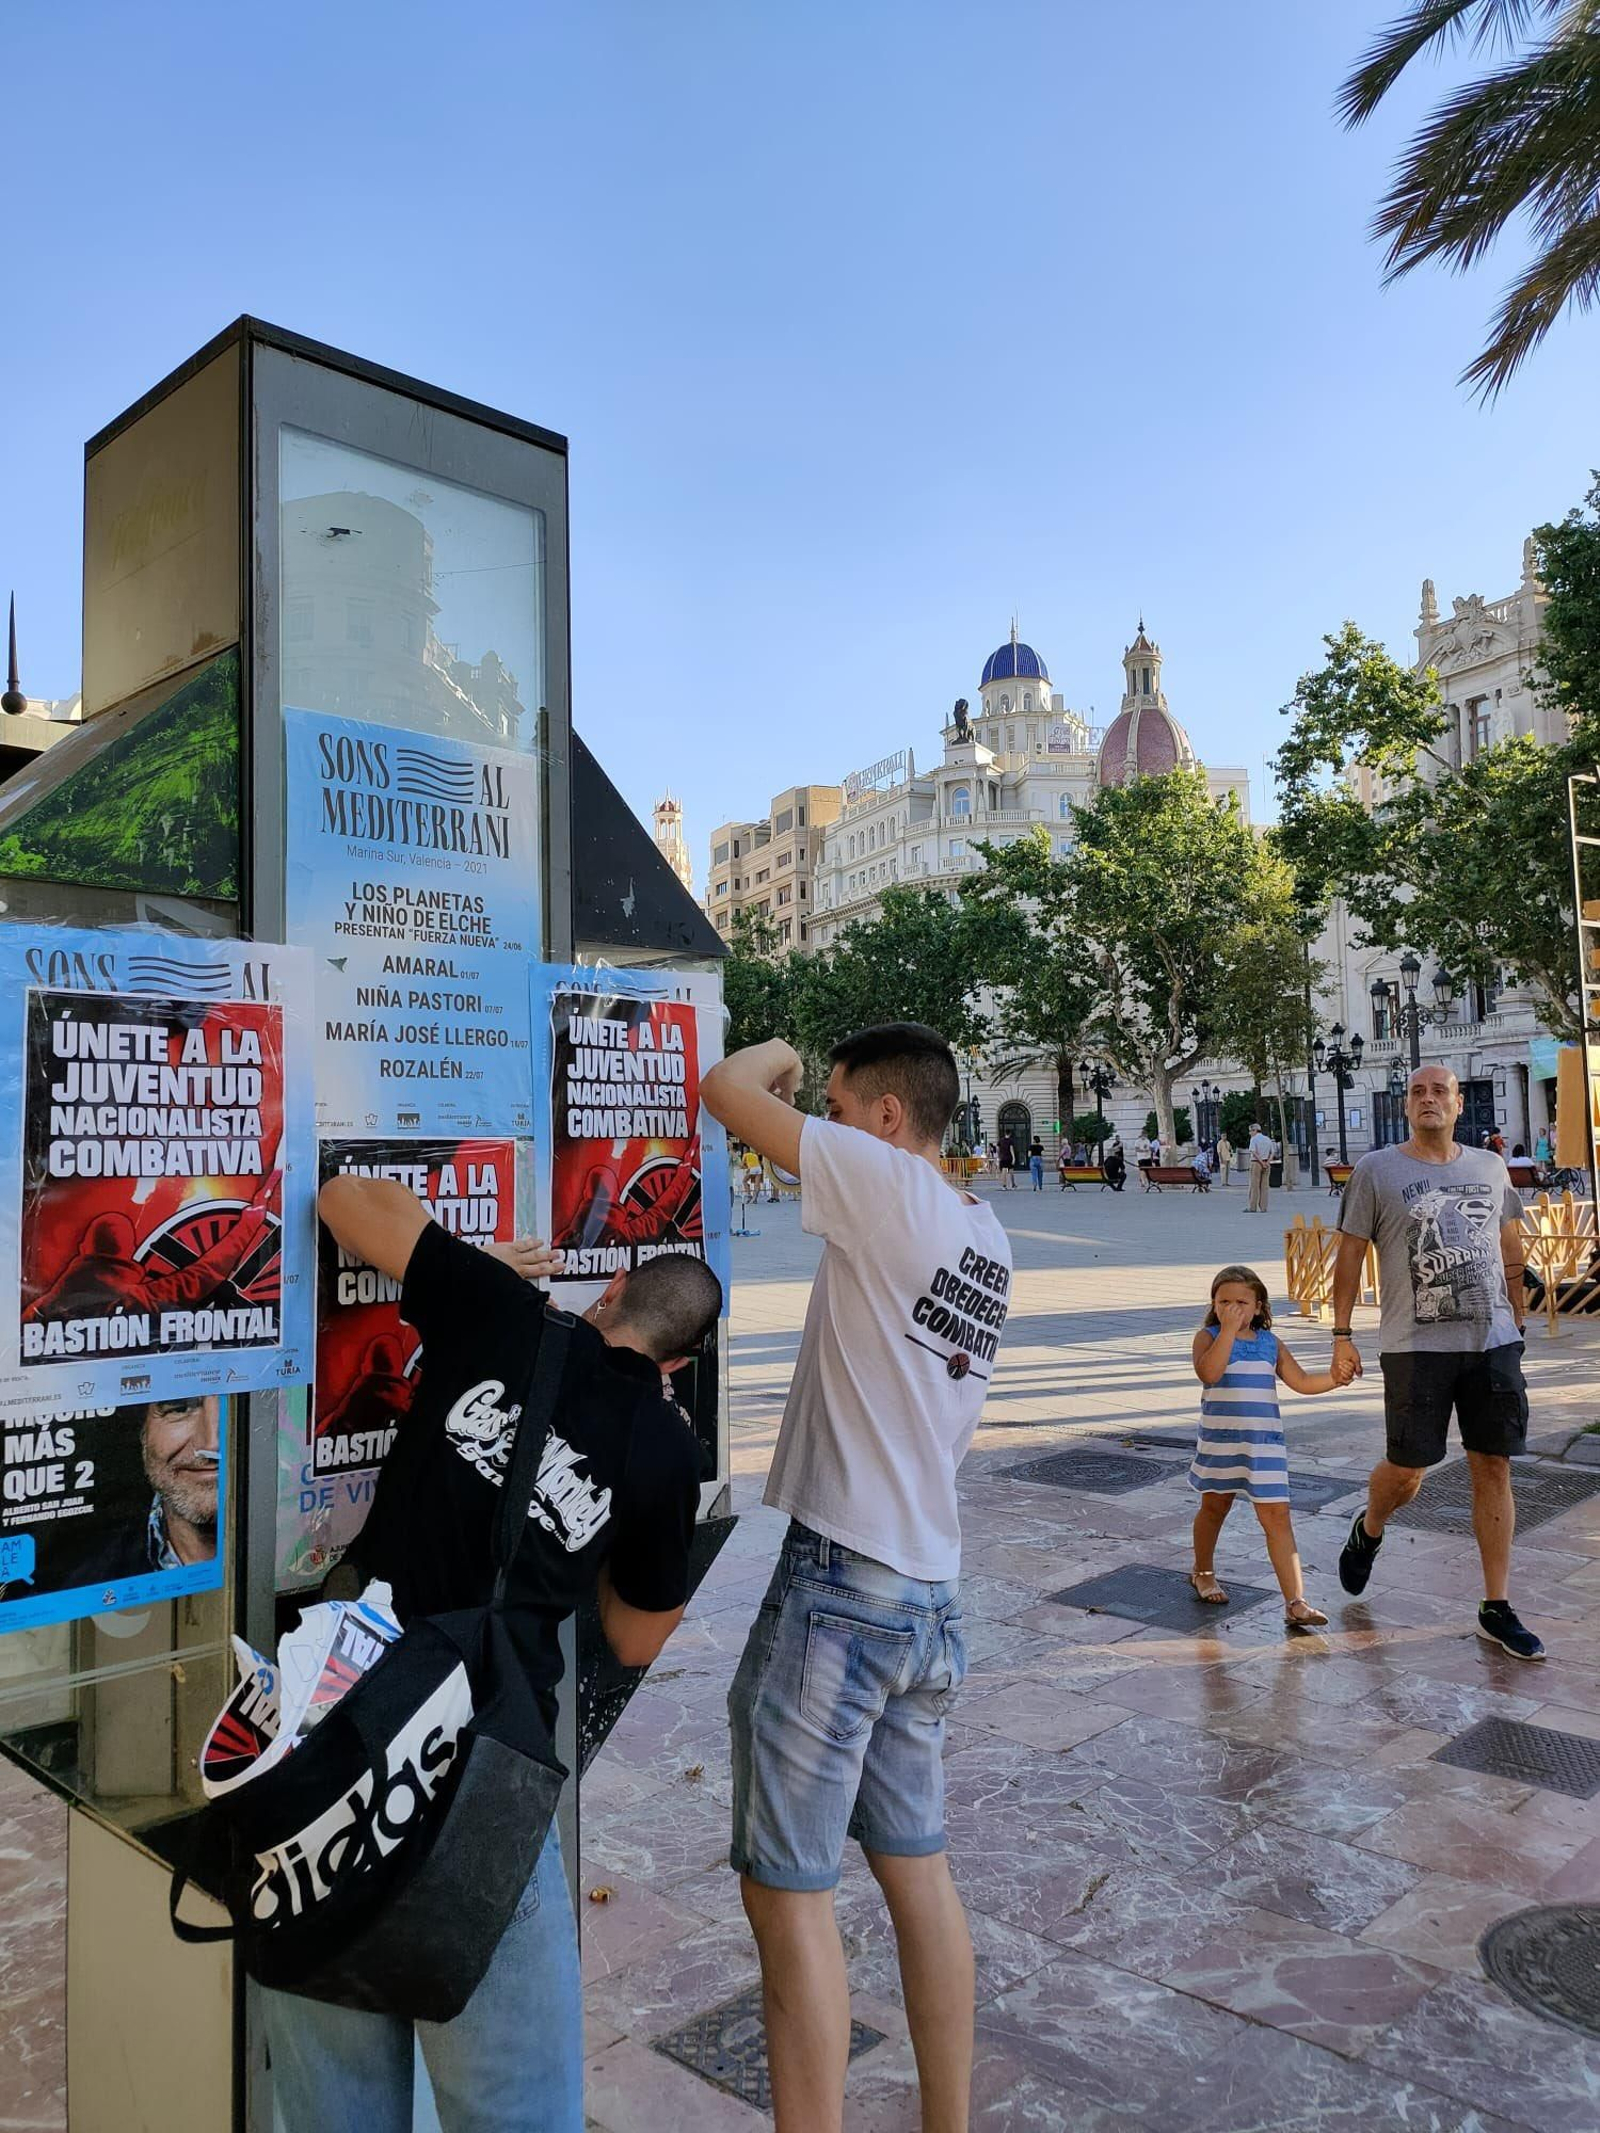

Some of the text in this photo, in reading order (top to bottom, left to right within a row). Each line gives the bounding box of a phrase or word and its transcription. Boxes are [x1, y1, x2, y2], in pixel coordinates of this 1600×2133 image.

[318, 733, 510, 810] SONS AL
[320, 787, 510, 859] MEDITERRANI
[347, 844, 384, 861] Marina
[387, 850, 406, 865] Sur,
[409, 853, 452, 870] Valencia
[464, 860, 488, 875] 2021
[352, 881, 485, 914] LOS PLANETAS
[334, 921, 405, 940] PRESENTAN
[344, 901, 492, 935] Y NIÑO DE ELCHE
[25, 948, 118, 992] SONS
[382, 955, 480, 980] AMARAL 01/07
[356, 985, 402, 1008] NIÑA
[408, 991, 482, 1013] PASTORI
[52, 1010, 263, 1065] ÚNETE A LA
[326, 1019, 389, 1043] MARÍA
[394, 1023, 440, 1045] JOSÉ
[445, 1028, 509, 1047] LLERGO
[568, 1007, 685, 1052] ÚNETE A LA
[380, 1056, 463, 1079] ROZALÉN
[567, 1048, 686, 1084] JUVENTUD
[51, 1062, 263, 1106] JUVENTUD
[567, 1082, 688, 1108] NACIONALISTA
[50, 1106, 262, 1137] NACIONALISTA
[567, 1109, 689, 1139] COMBATIVA
[49, 1140, 263, 1178] COMBATIVA
[438, 1164, 459, 1196] A
[467, 1163, 499, 1196] LA
[1401, 1179, 1431, 1204] NEW!!
[1415, 1248, 1491, 1284] SUPERMAN
[1465, 1261, 1487, 1275] HERO
[23, 1306, 279, 1358] BASTIÓN FRONTAL
[276, 1366, 301, 1377] TURIA
[4, 1425, 76, 1465] MÁS
[3, 1460, 95, 1503] QUE 2
[2, 1496, 85, 1517] ALBERTO SAN JUAN
[299, 1486, 335, 1513] DE
[2, 1518, 10, 1527] Y
[10, 1511, 56, 1526] FERNANDO
[251, 1724, 458, 1928] didas
